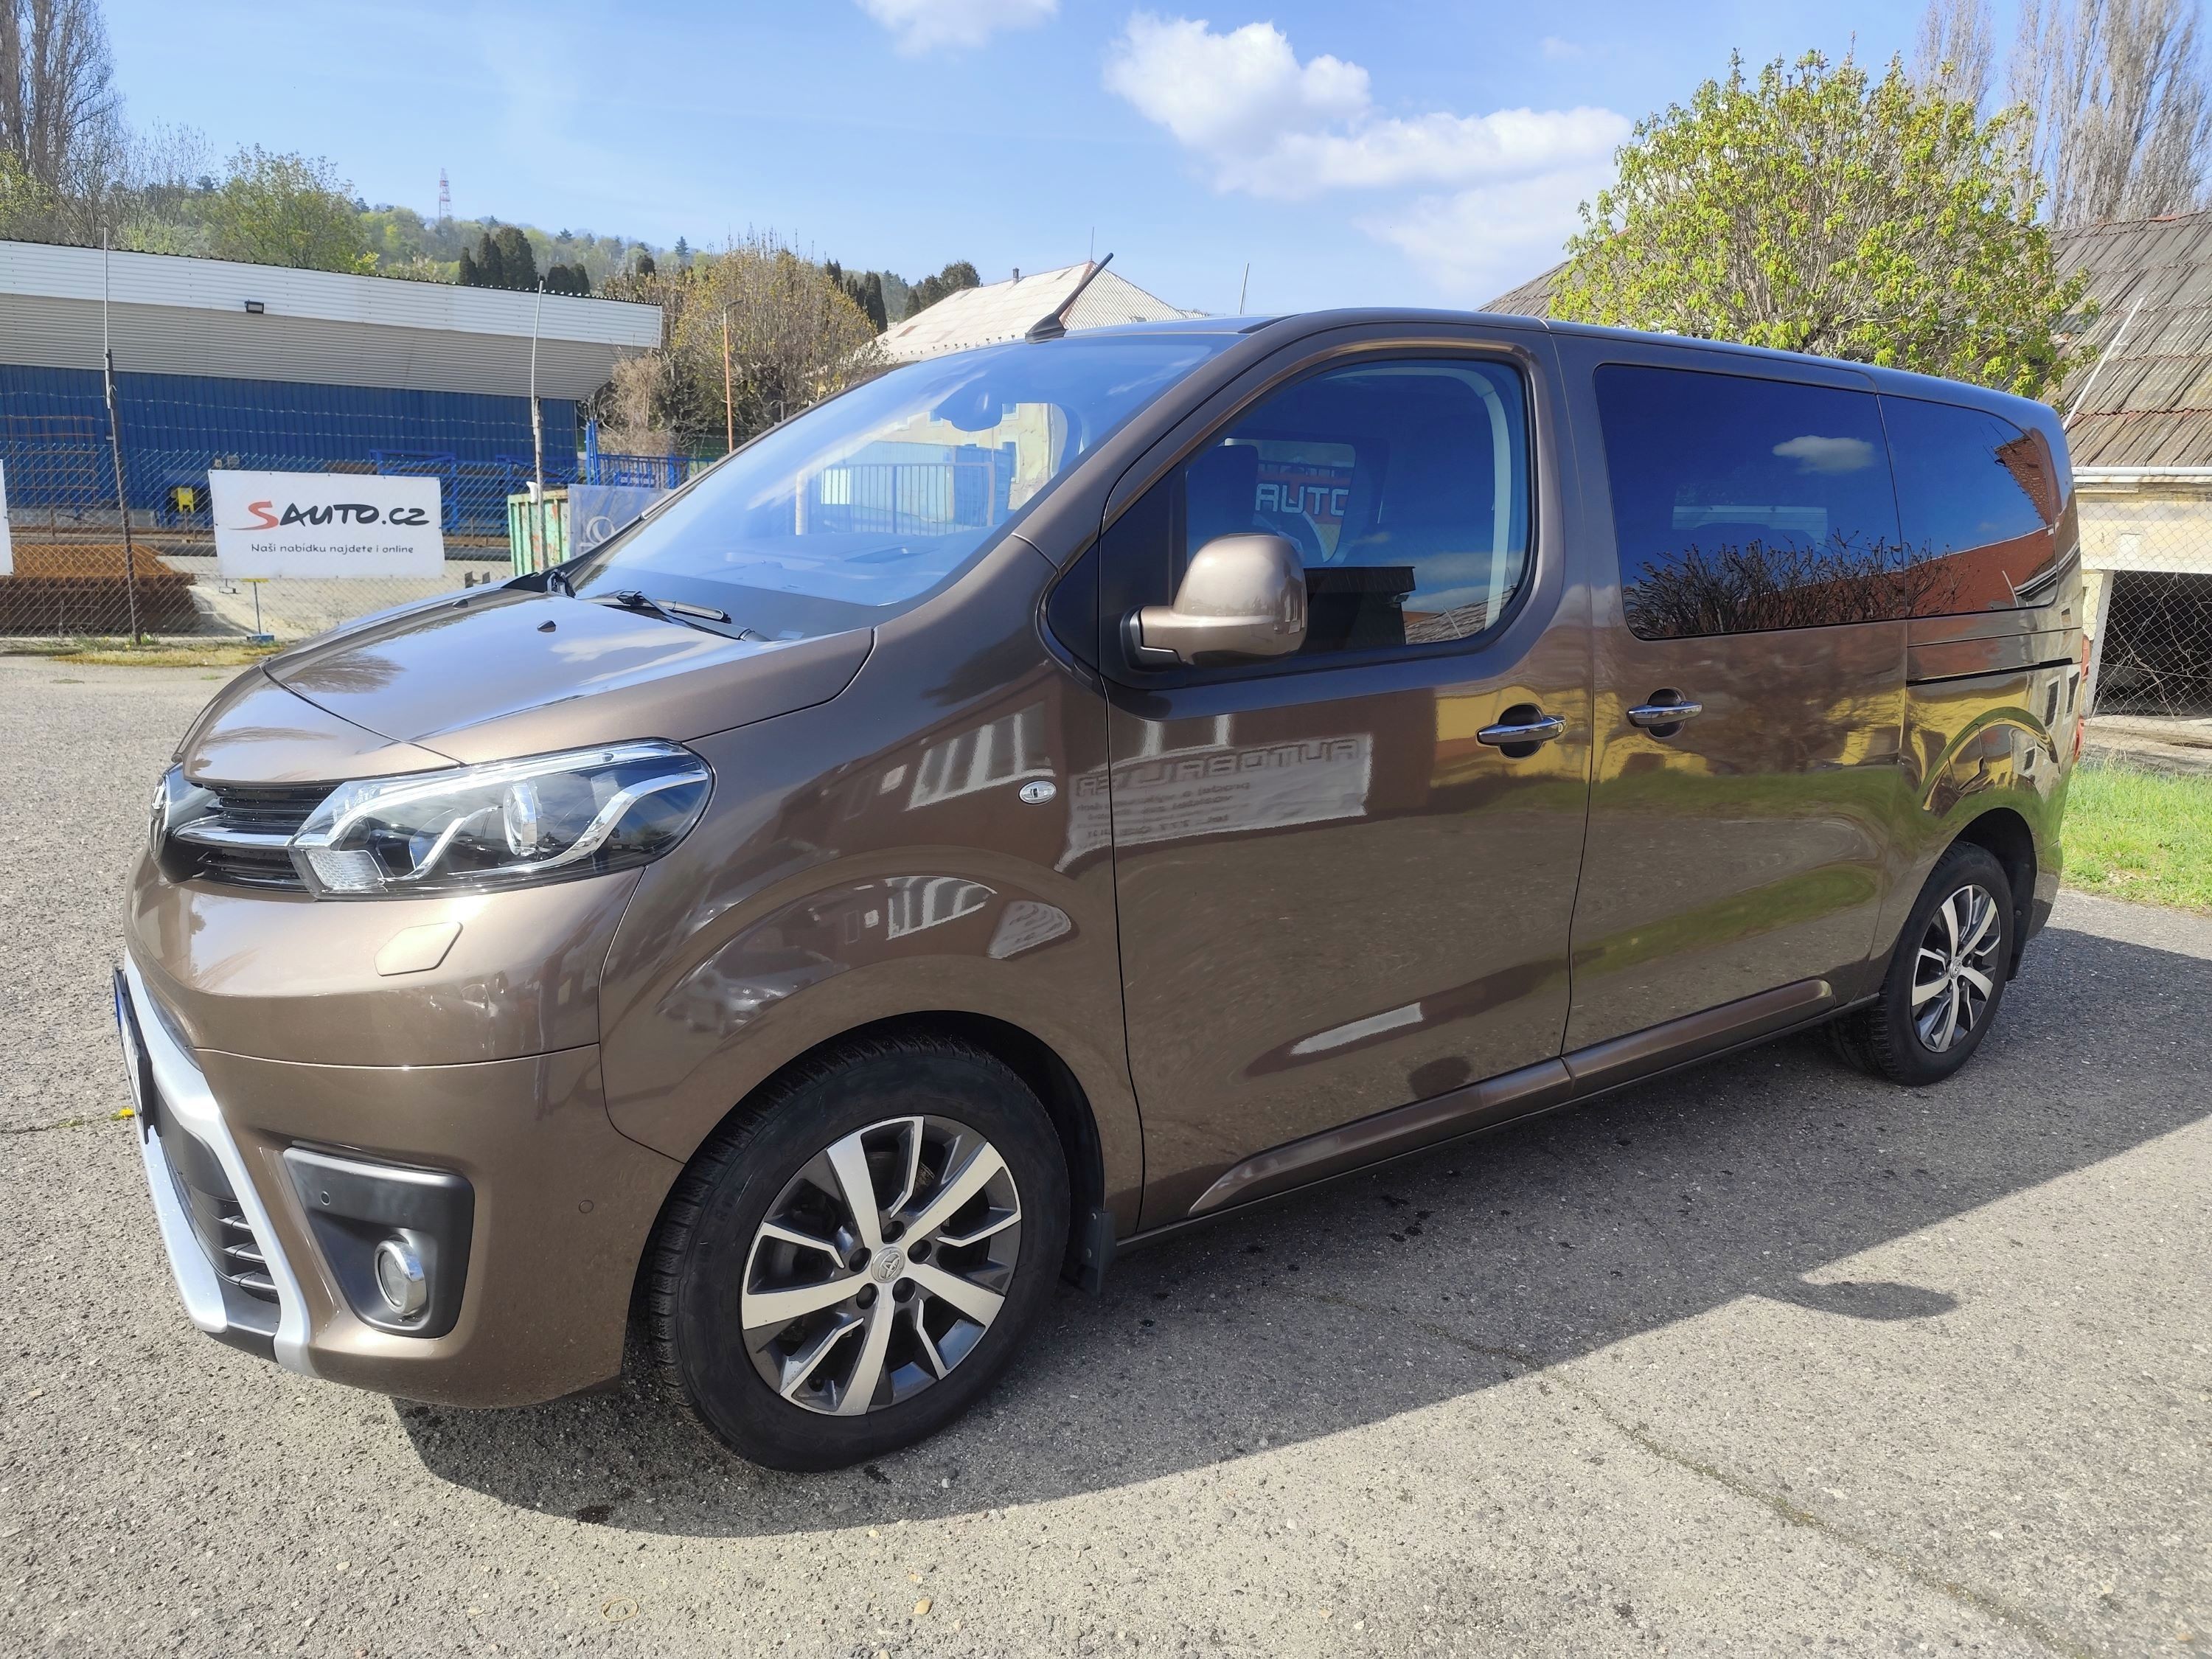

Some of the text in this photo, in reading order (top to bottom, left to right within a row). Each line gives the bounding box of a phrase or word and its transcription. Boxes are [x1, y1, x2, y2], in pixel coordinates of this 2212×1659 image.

[251, 543, 276, 553] Naši
[280, 543, 326, 553] nabídku
[330, 544, 372, 555] najdete
[382, 545, 414, 554] online
